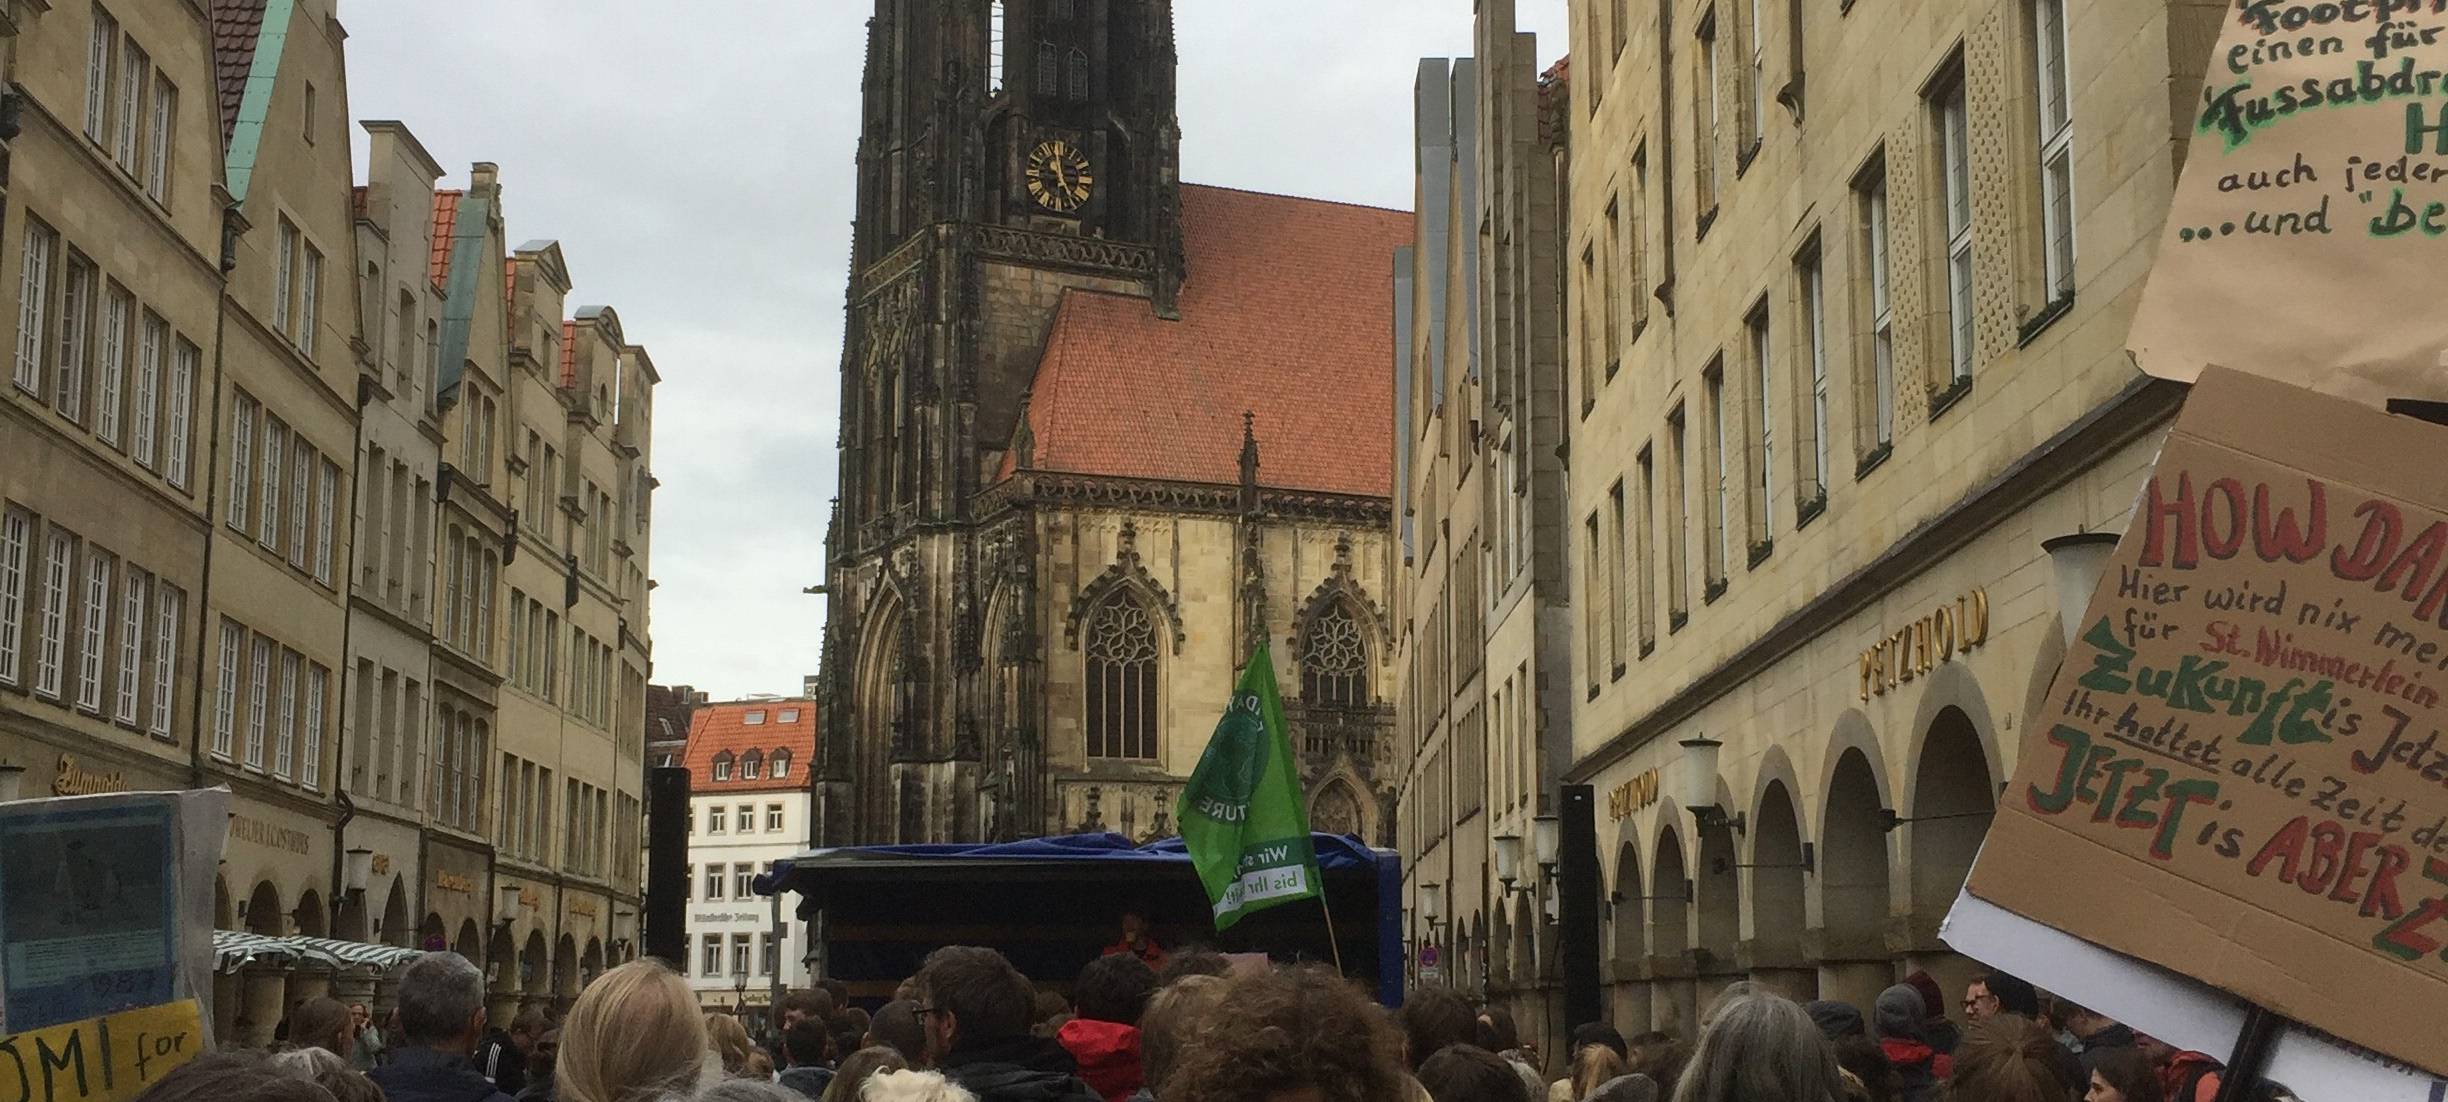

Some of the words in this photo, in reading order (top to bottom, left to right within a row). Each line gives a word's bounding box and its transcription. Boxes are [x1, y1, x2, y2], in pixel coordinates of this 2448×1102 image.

[2227, 36, 2345, 75] einen
[2365, 21, 2447, 60] für
[2199, 56, 2448, 149] Fussabdr
[2218, 153, 2318, 192] auch
[2139, 470, 2327, 571] HOW
[1860, 585, 1989, 704] PETZHOLD
[2118, 564, 2190, 605] Hier
[2204, 580, 2287, 616] wird
[2297, 598, 2362, 634] nix
[2123, 607, 2180, 648] für
[2199, 620, 2251, 658] St.
[2254, 624, 2440, 709] Nimmerlein
[2063, 689, 2110, 725] Ihr
[2231, 753, 2306, 798] alle
[2309, 775, 2407, 833] Zeit
[2321, 697, 2362, 736] is
[2351, 703, 2448, 781] Jetz
[2026, 723, 2221, 862] JETZT
[2195, 799, 2245, 859] is
[2246, 815, 2412, 921] ABER
[135, 1031, 188, 1082] for
